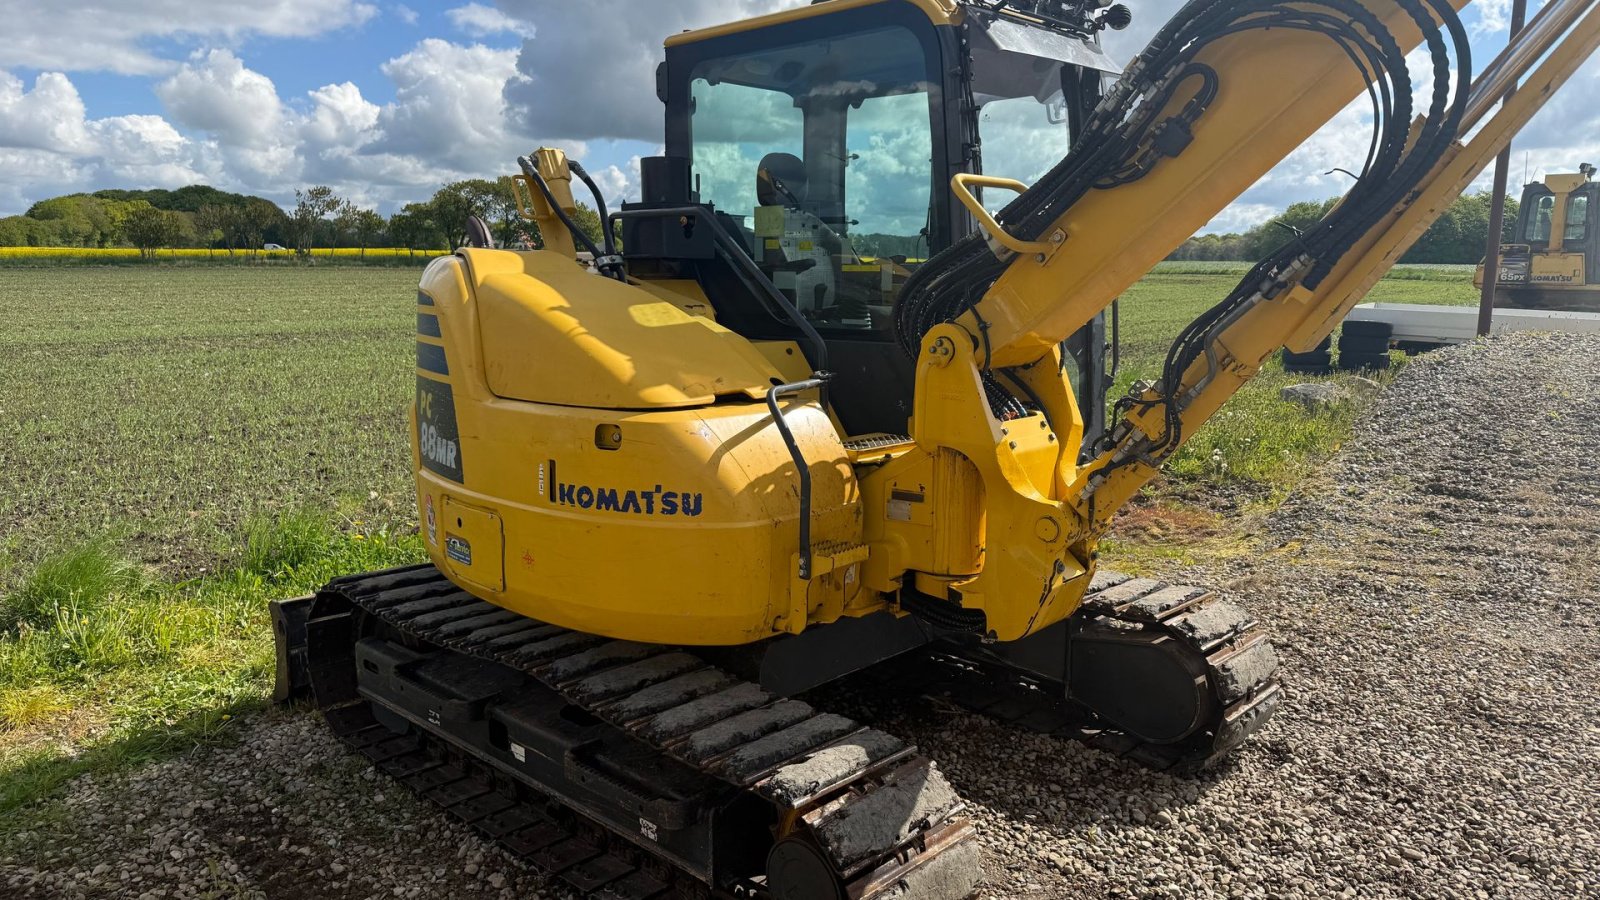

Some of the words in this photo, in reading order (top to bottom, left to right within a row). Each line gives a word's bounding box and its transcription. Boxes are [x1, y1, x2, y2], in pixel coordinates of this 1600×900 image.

[1500, 273, 1525, 281] 65PX
[420, 389, 433, 418] PC
[421, 421, 457, 469] 88MR
[558, 482, 703, 516] KOMATSU
